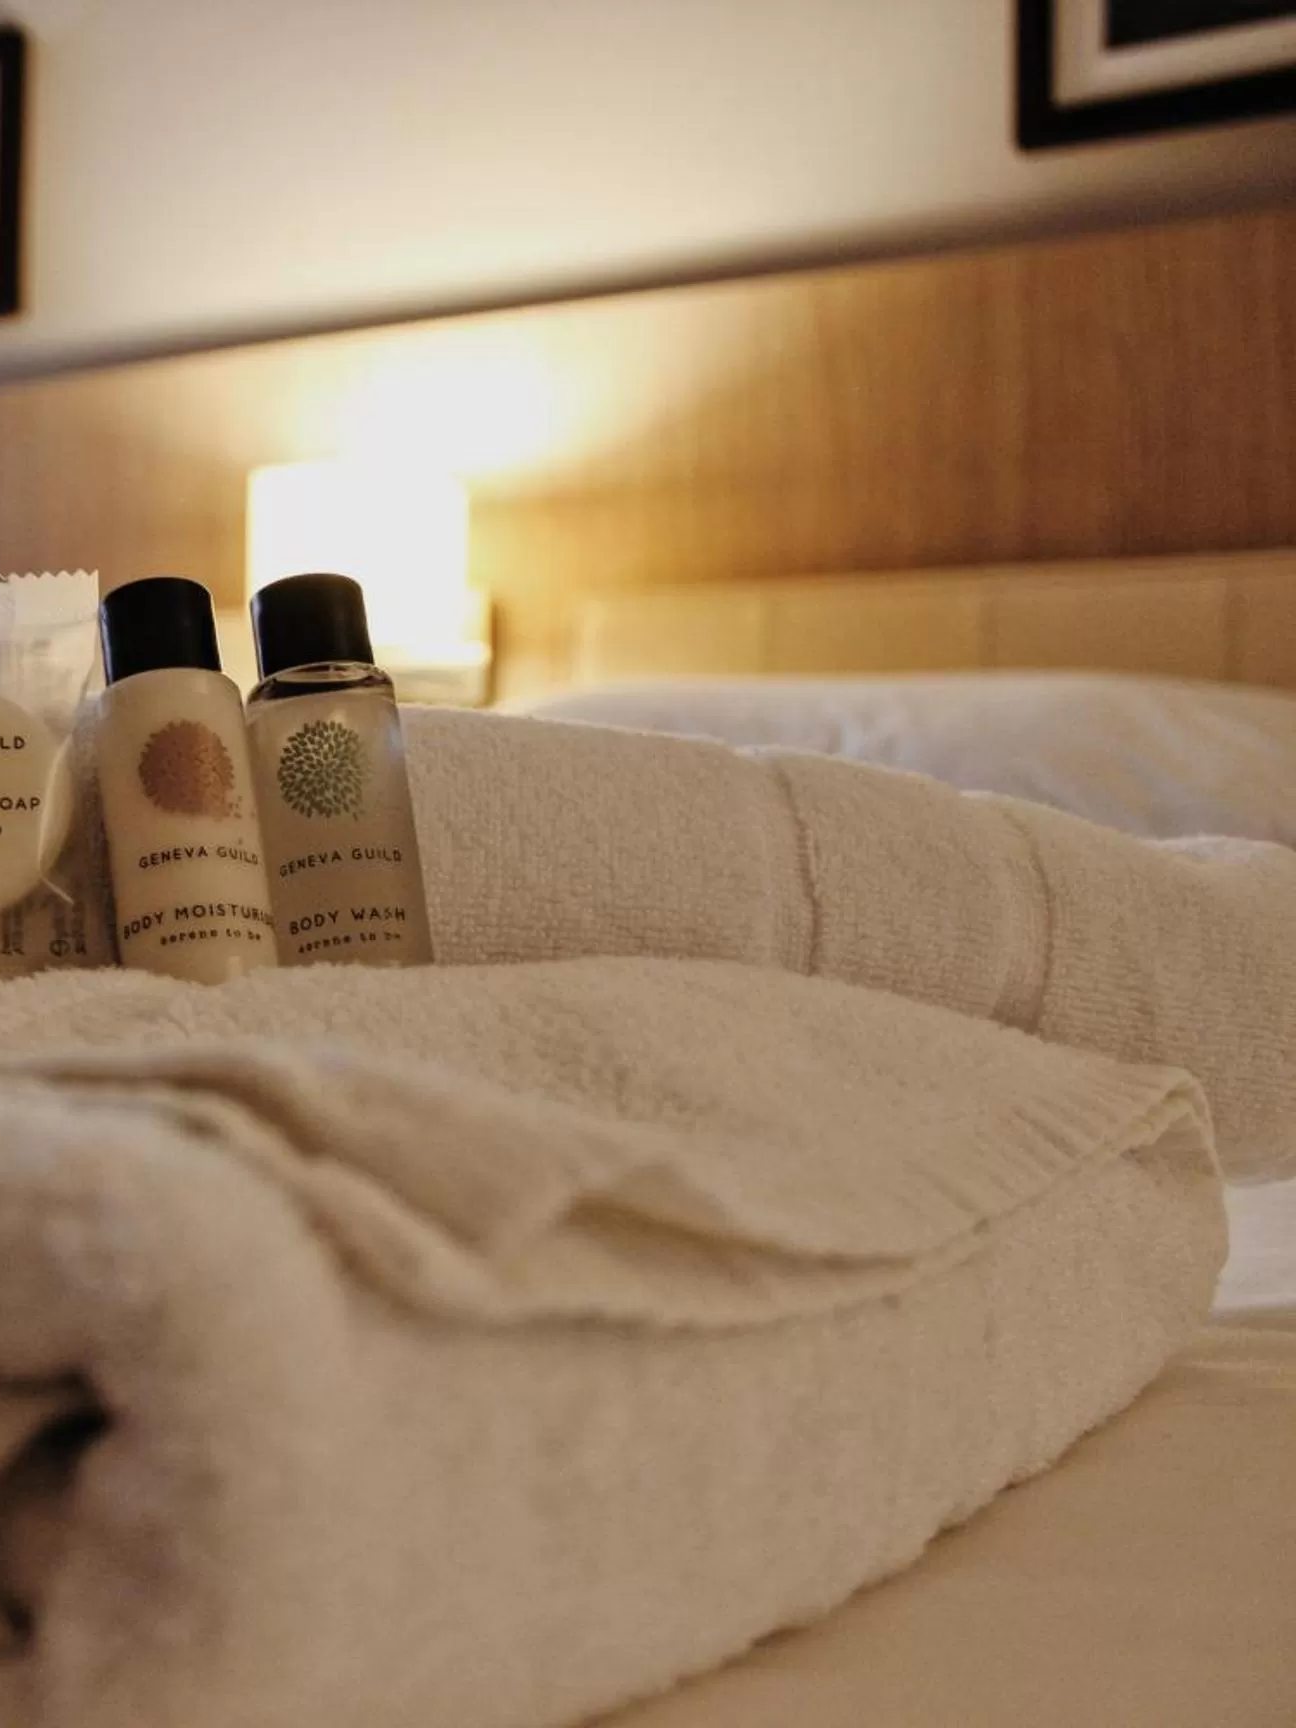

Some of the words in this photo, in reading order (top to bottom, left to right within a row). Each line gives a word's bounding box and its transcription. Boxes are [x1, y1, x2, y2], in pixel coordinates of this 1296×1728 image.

[138, 846, 208, 869] GENEVA
[216, 846, 259, 866] GUILD
[279, 850, 343, 878] GENEVA
[351, 847, 402, 862] GUILD
[123, 911, 164, 941] BODY
[289, 910, 340, 936] BODY
[350, 906, 406, 921] WASH
